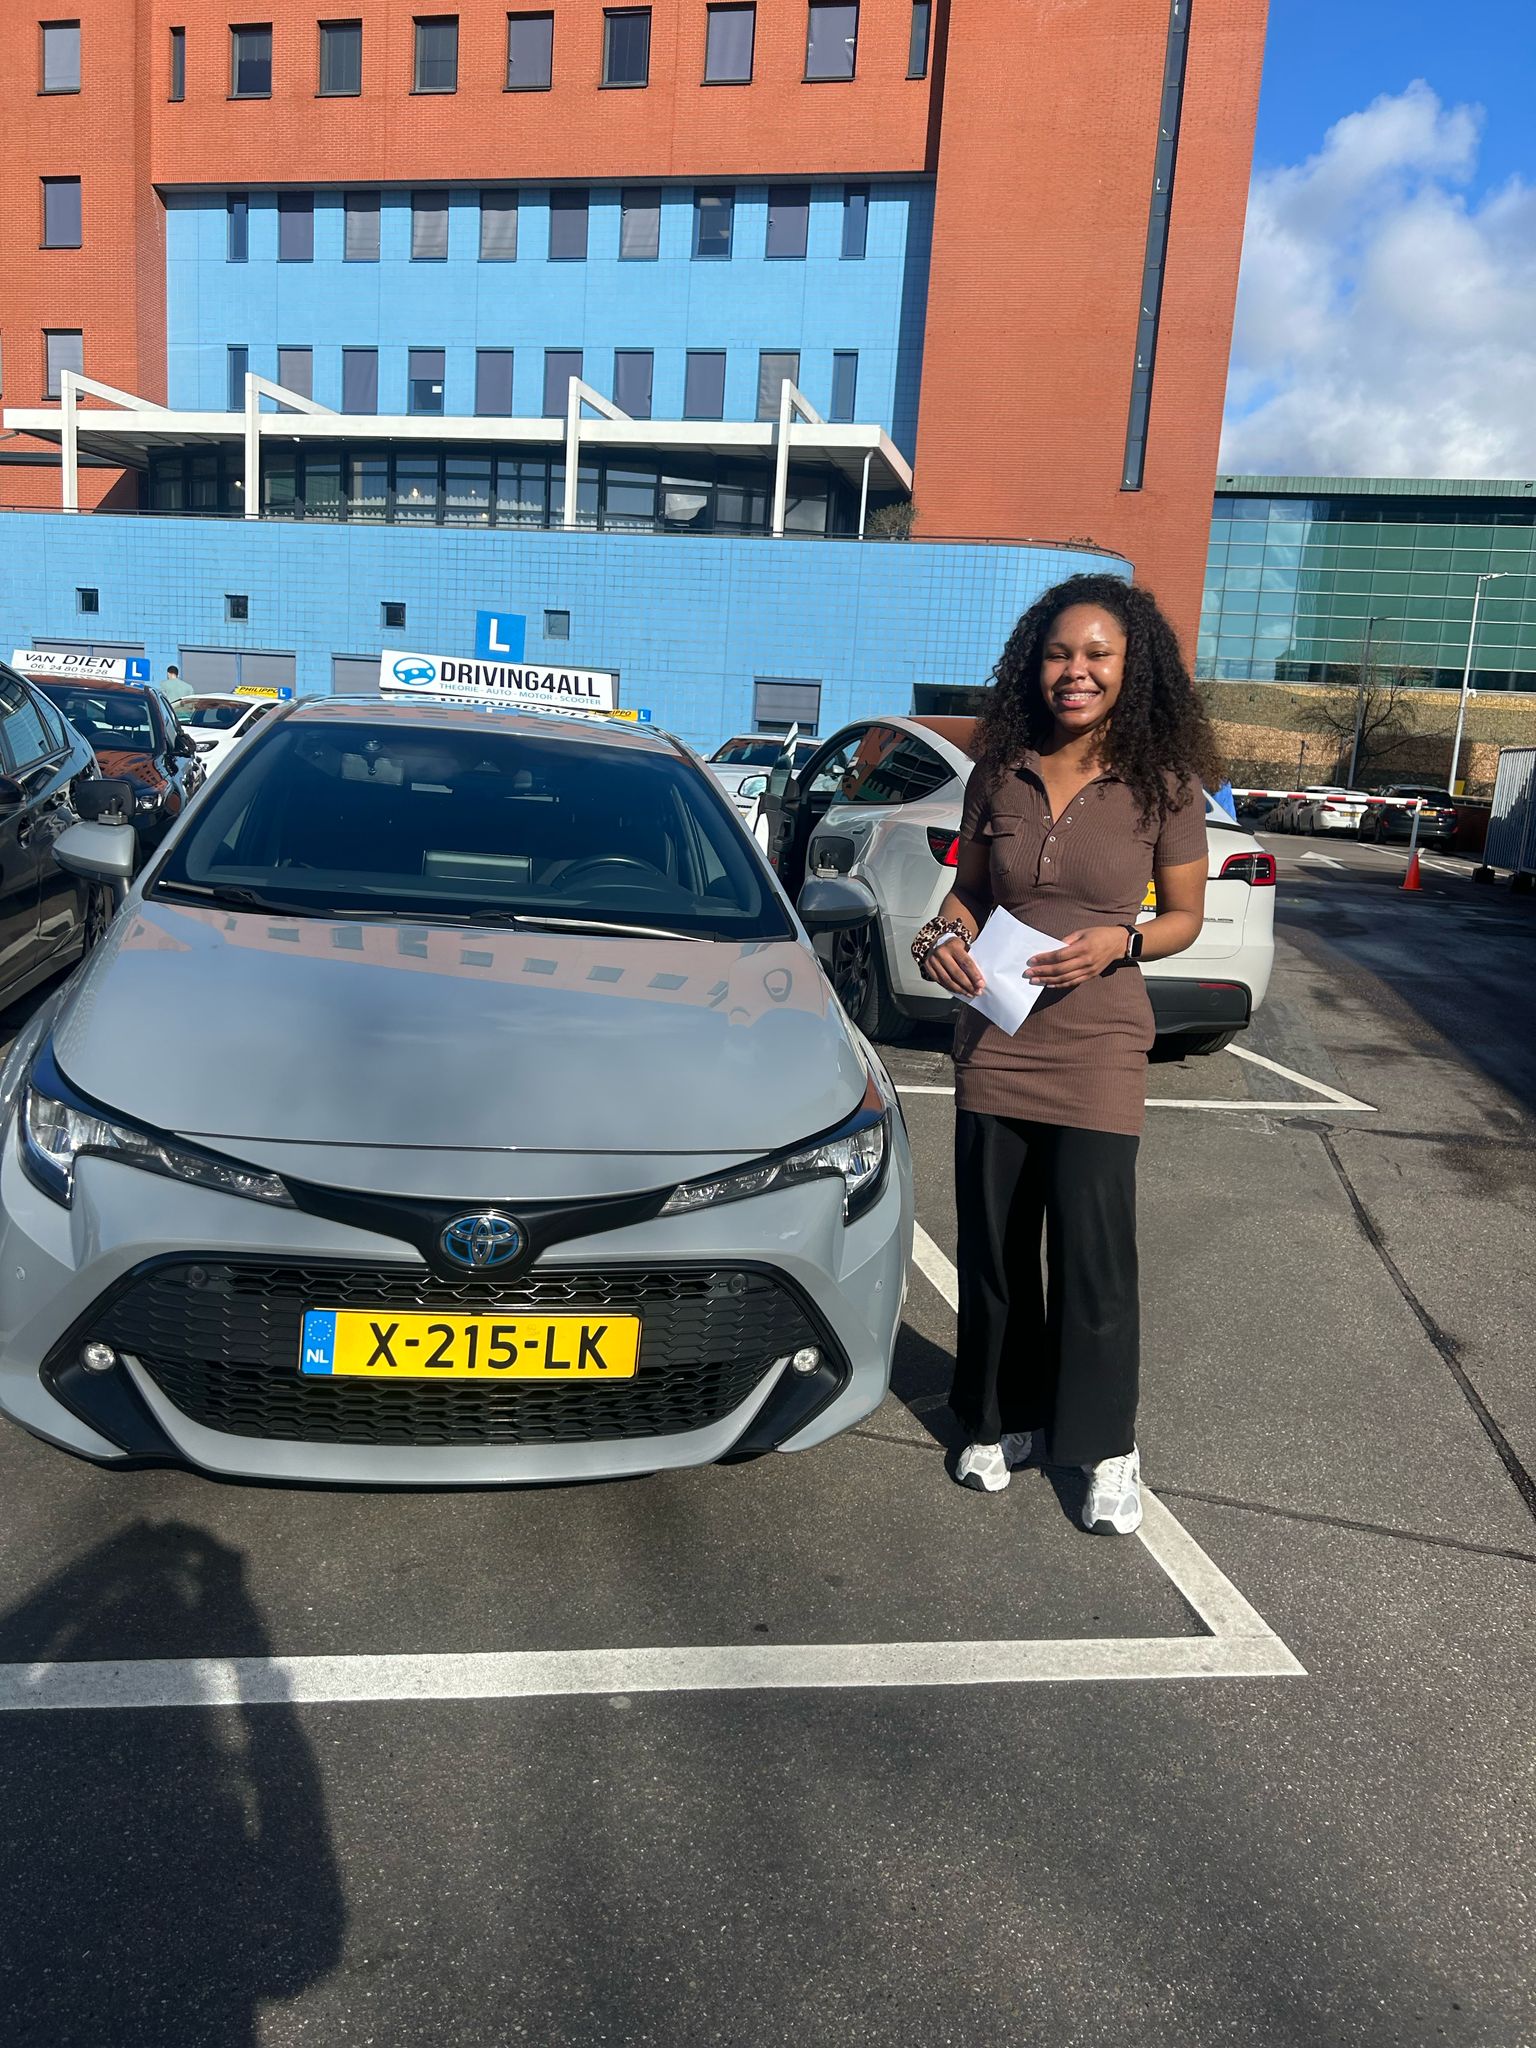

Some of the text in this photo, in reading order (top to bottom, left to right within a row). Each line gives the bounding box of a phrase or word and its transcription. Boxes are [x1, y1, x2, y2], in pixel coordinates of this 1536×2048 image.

[488, 618, 511, 652] L
[25, 653, 116, 668] VAN DIEN
[131, 661, 142, 677] L
[440, 661, 601, 698] DRIVING4ALL
[280, 689, 286, 697] L
[440, 683, 479, 693] THEORIE
[519, 691, 552, 701] MOTOR
[560, 695, 601, 705] SCOOTER
[640, 711, 647, 720] L
[366, 1322, 608, 1369] X-215-LK
[306, 1349, 329, 1363] NL
